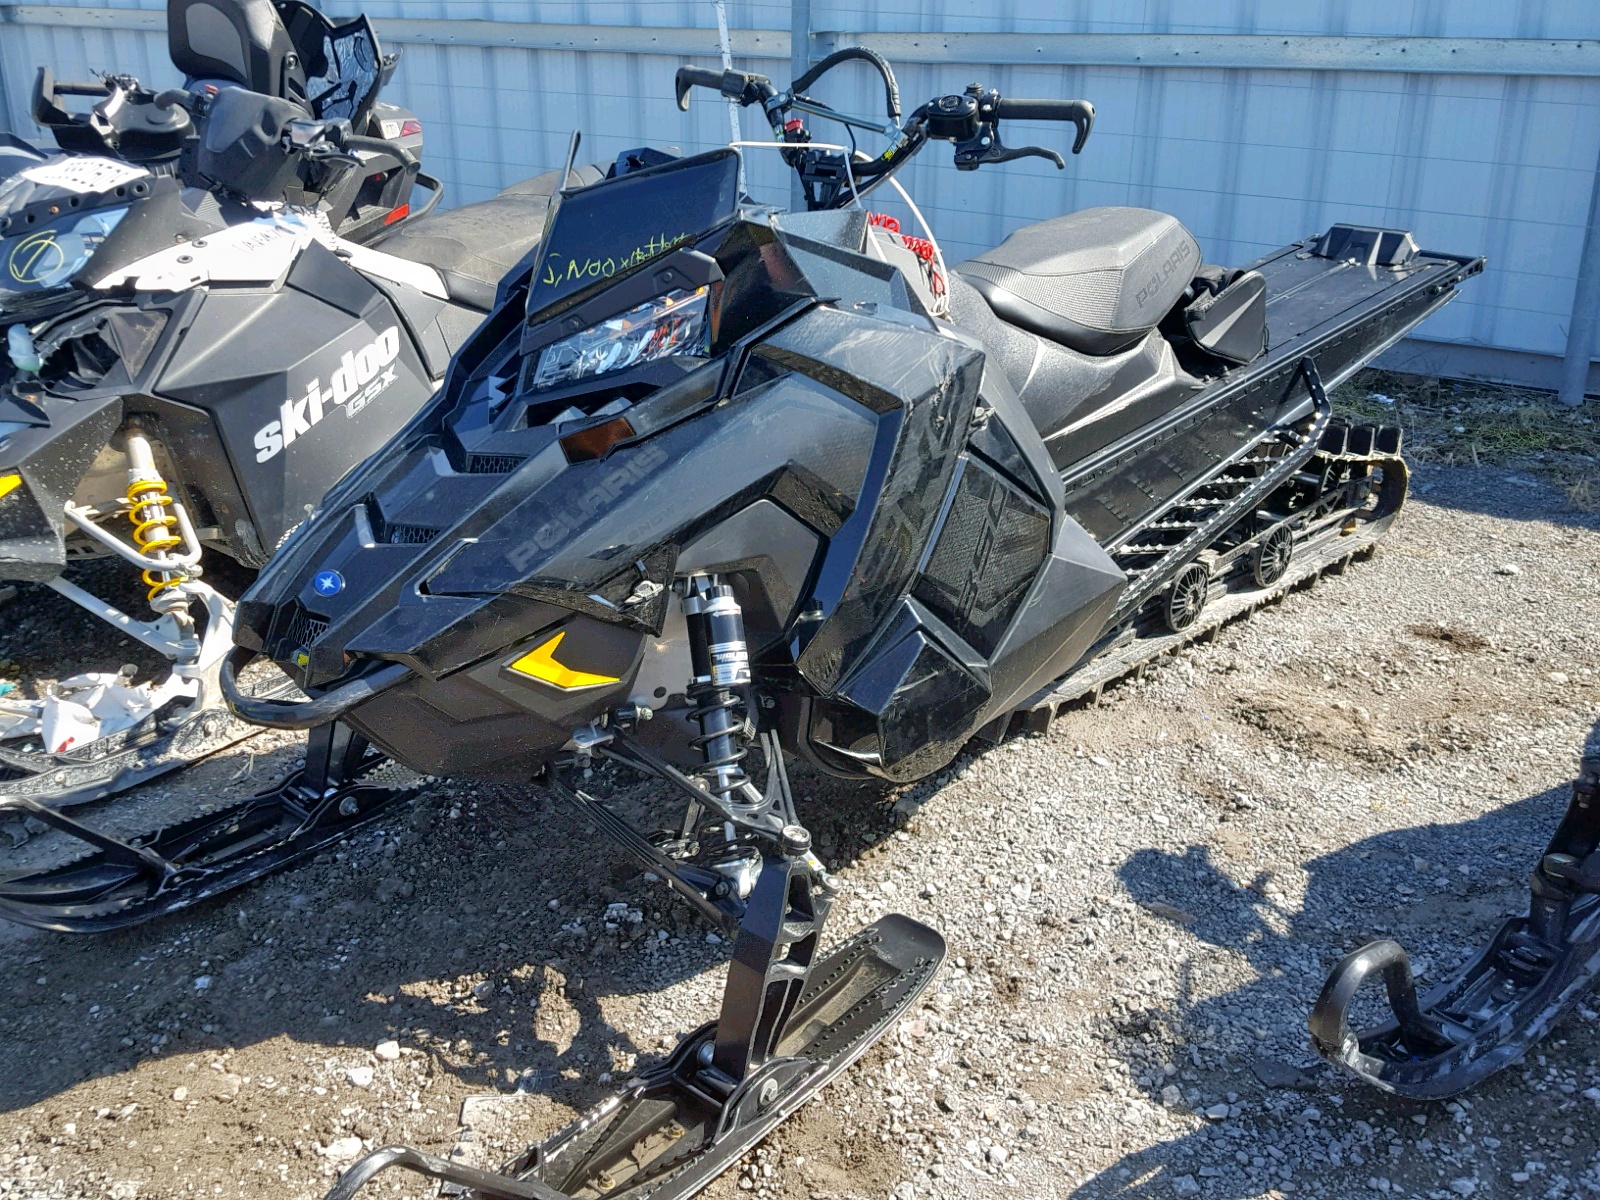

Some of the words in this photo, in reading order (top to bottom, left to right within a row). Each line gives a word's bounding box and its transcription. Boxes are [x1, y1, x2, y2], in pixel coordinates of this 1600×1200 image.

[1134, 239, 1191, 309] POLARIS
[253, 325, 400, 464] ski-doo
[347, 363, 399, 420] GSX
[503, 446, 669, 573] POLARIS
